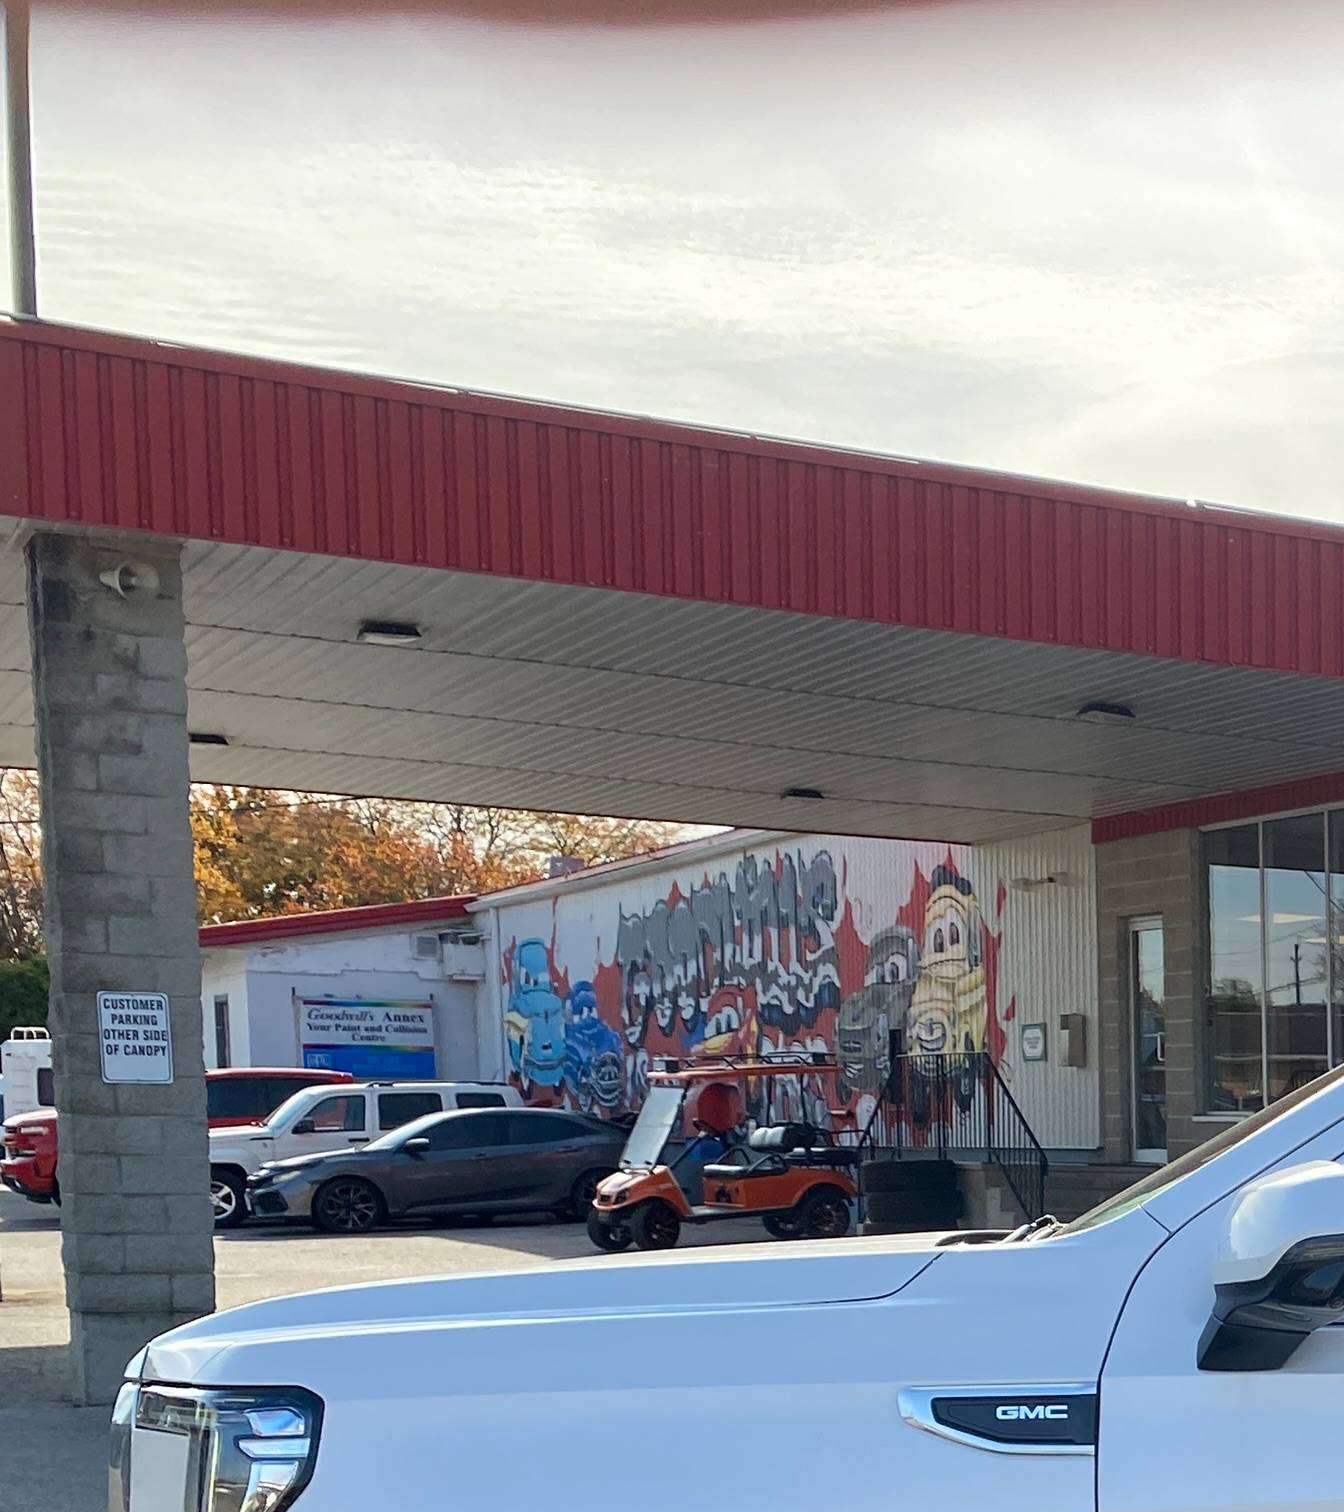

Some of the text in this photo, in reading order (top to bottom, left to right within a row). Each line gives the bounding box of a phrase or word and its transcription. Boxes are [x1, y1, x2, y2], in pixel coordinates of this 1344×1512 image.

[103, 998, 164, 1011] CUSTOMER
[111, 1013, 158, 1026] PARKING
[383, 1011, 425, 1024] Annex
[306, 1022, 331, 1032] Your
[334, 1023, 361, 1033] Paint
[364, 1024, 383, 1033] and
[103, 1028, 169, 1042] OTHER SIDE
[105, 1043, 167, 1057] OF CANOPY
[995, 1405, 1069, 1420] GMC
